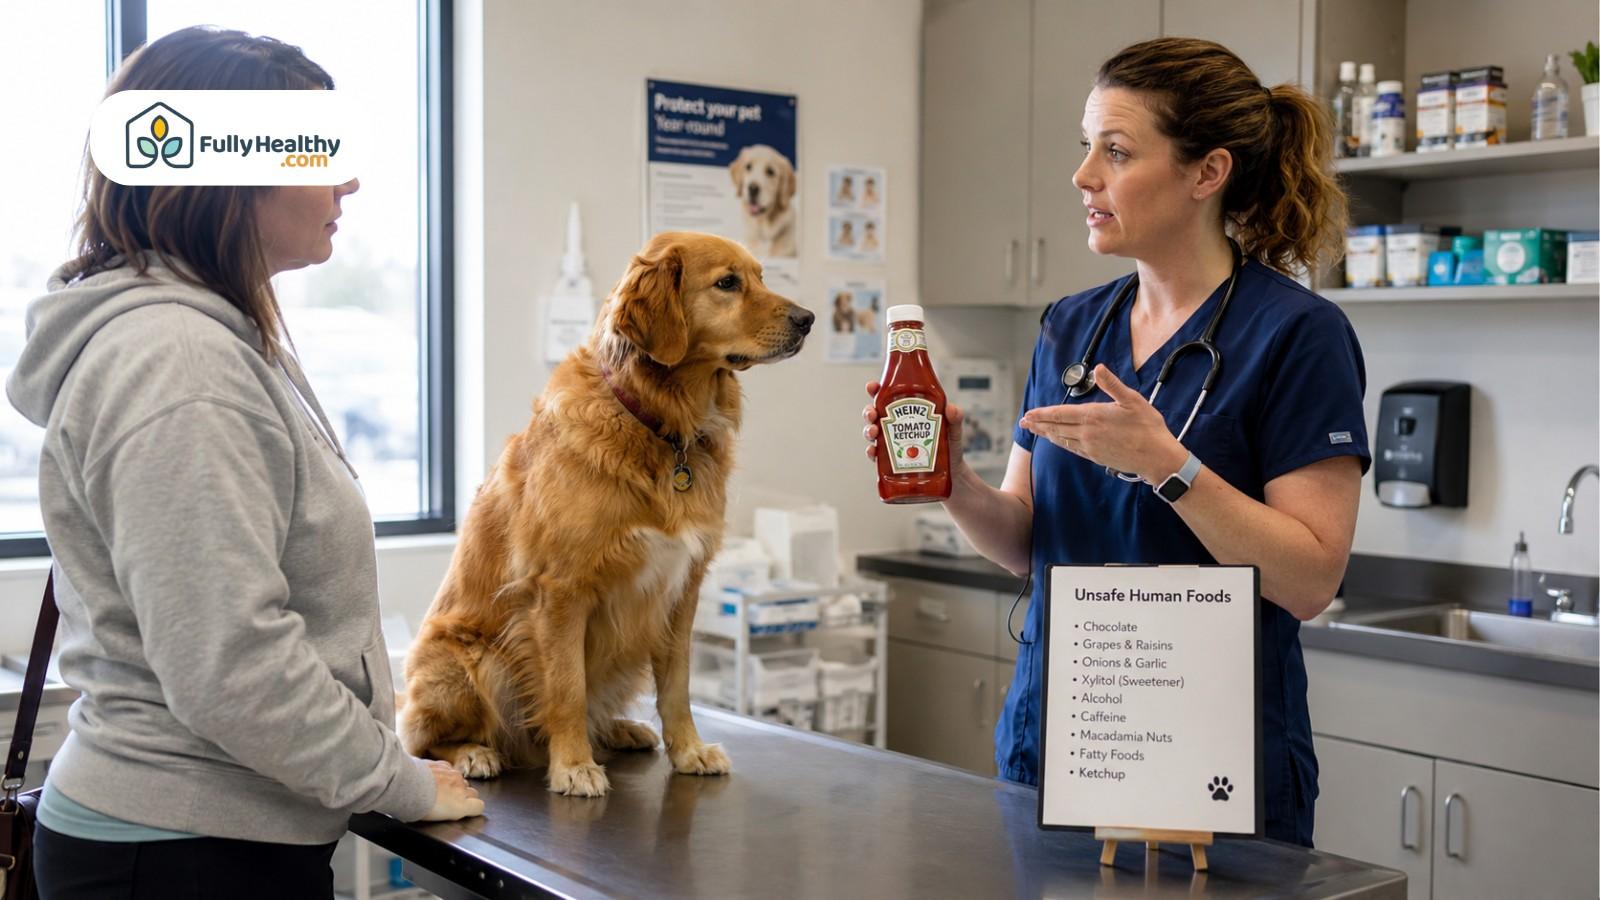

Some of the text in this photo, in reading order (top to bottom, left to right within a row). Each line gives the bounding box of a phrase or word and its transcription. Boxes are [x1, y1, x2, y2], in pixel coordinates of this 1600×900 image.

[654, 93, 762, 123] Protect your pet
[895, 405, 927, 417] HEINZ
[892, 422, 931, 432] TOMATO
[894, 431, 930, 439] KETCHUP
[1075, 588, 1232, 603] Unsafe Human Foods
[1083, 621, 1138, 632] Chocolate
[1082, 638, 1174, 652] Grapes & Raisins
[1082, 656, 1167, 669] Onions & Garlic
[1081, 674, 1185, 689] Xylitol (Sweetener)
[1081, 692, 1123, 704] Alcohol
[1080, 711, 1127, 723] Caffeine
[1080, 729, 1173, 743] Macadamia Nuts
[1079, 748, 1145, 762] Fatty Foods
[1079, 767, 1126, 782] Ketchup
